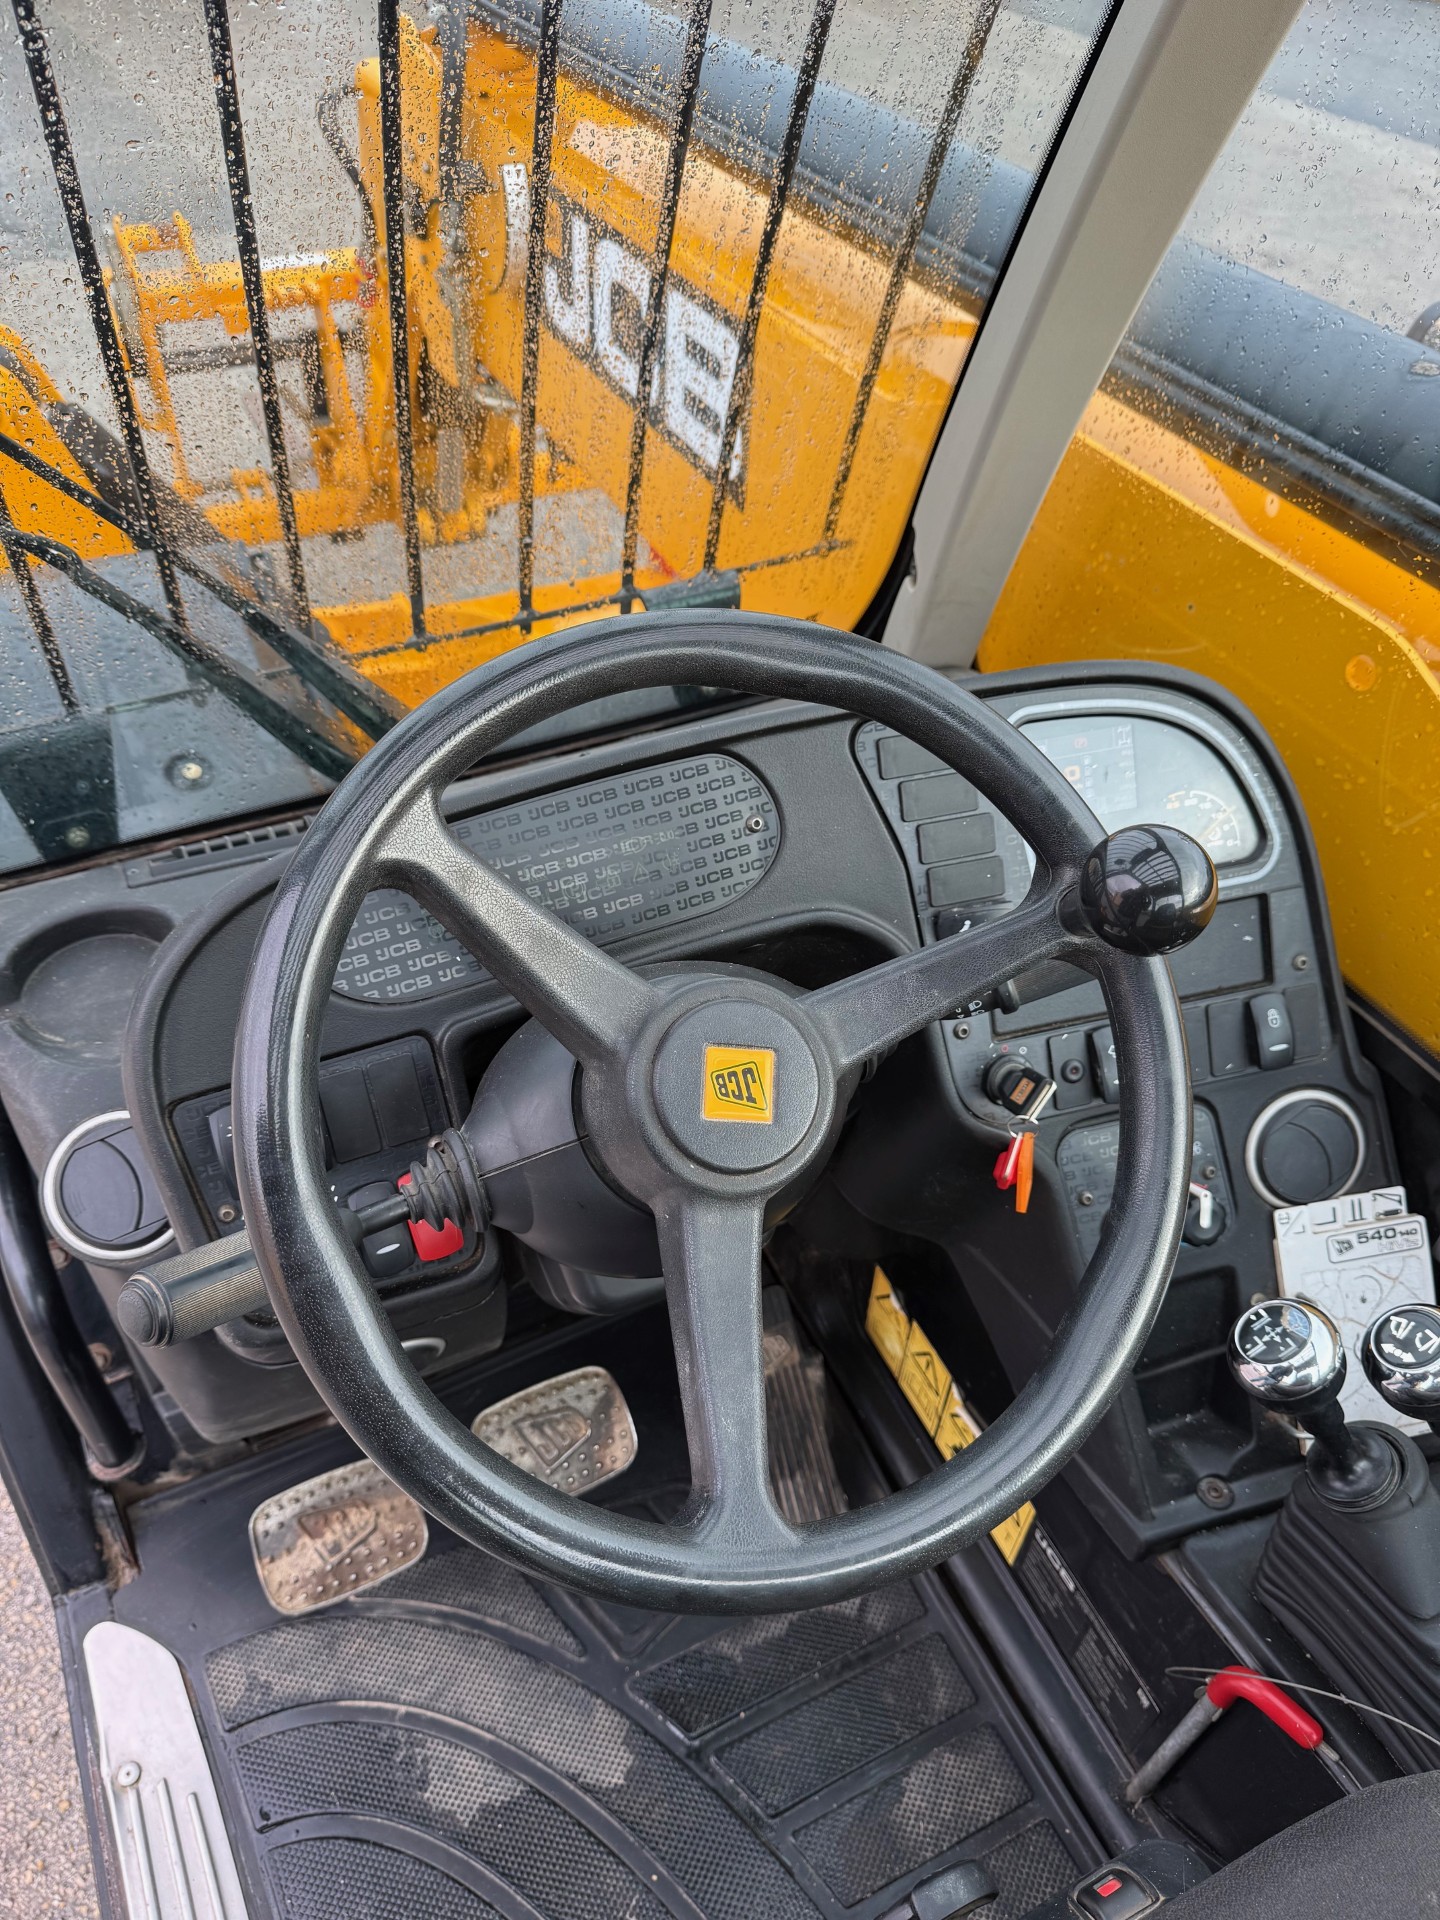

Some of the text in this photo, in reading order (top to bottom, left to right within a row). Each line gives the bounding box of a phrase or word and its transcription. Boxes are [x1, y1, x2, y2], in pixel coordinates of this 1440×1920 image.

[545, 215, 743, 481] JCB
[478, 813, 522, 834] JCB
[528, 800, 570, 821] JCB
[577, 788, 617, 808] JCB
[624, 776, 664, 795] JCB
[670, 763, 709, 783] JCB
[508, 825, 551, 845] JCB
[557, 812, 598, 832] JCB
[605, 800, 645, 819] JCB
[651, 787, 691, 807] JCB
[697, 775, 735, 794] JCB
[633, 811, 672, 829] JCB
[678, 799, 717, 818] JCB
[723, 786, 762, 806] JCB
[517, 861, 561, 882] JCB
[566, 848, 608, 868] JCB
[673, 822, 699, 838] CB
[705, 810, 743, 829] JCB
[546, 872, 589, 893] JCB
[687, 833, 725, 852] JCB
[669, 856, 707, 876] JCB
[713, 844, 751, 863] JCB
[603, 893, 644, 914] JCB
[695, 867, 733, 887] JCB
[364, 903, 411, 924] JCB
[585, 918, 625, 938] JCB
[632, 904, 671, 924] JCB
[677, 890, 715, 911] JCB
[337, 954, 370, 972] CB
[375, 939, 422, 961] JCB
[347, 928, 391, 950] JCB
[354, 964, 402, 987] JCB
[407, 951, 452, 971] JCB
[386, 961, 482, 997] JCB JCB
[715, 1067, 757, 1104] JCB
[1099, 1145, 1118, 1158] JC
